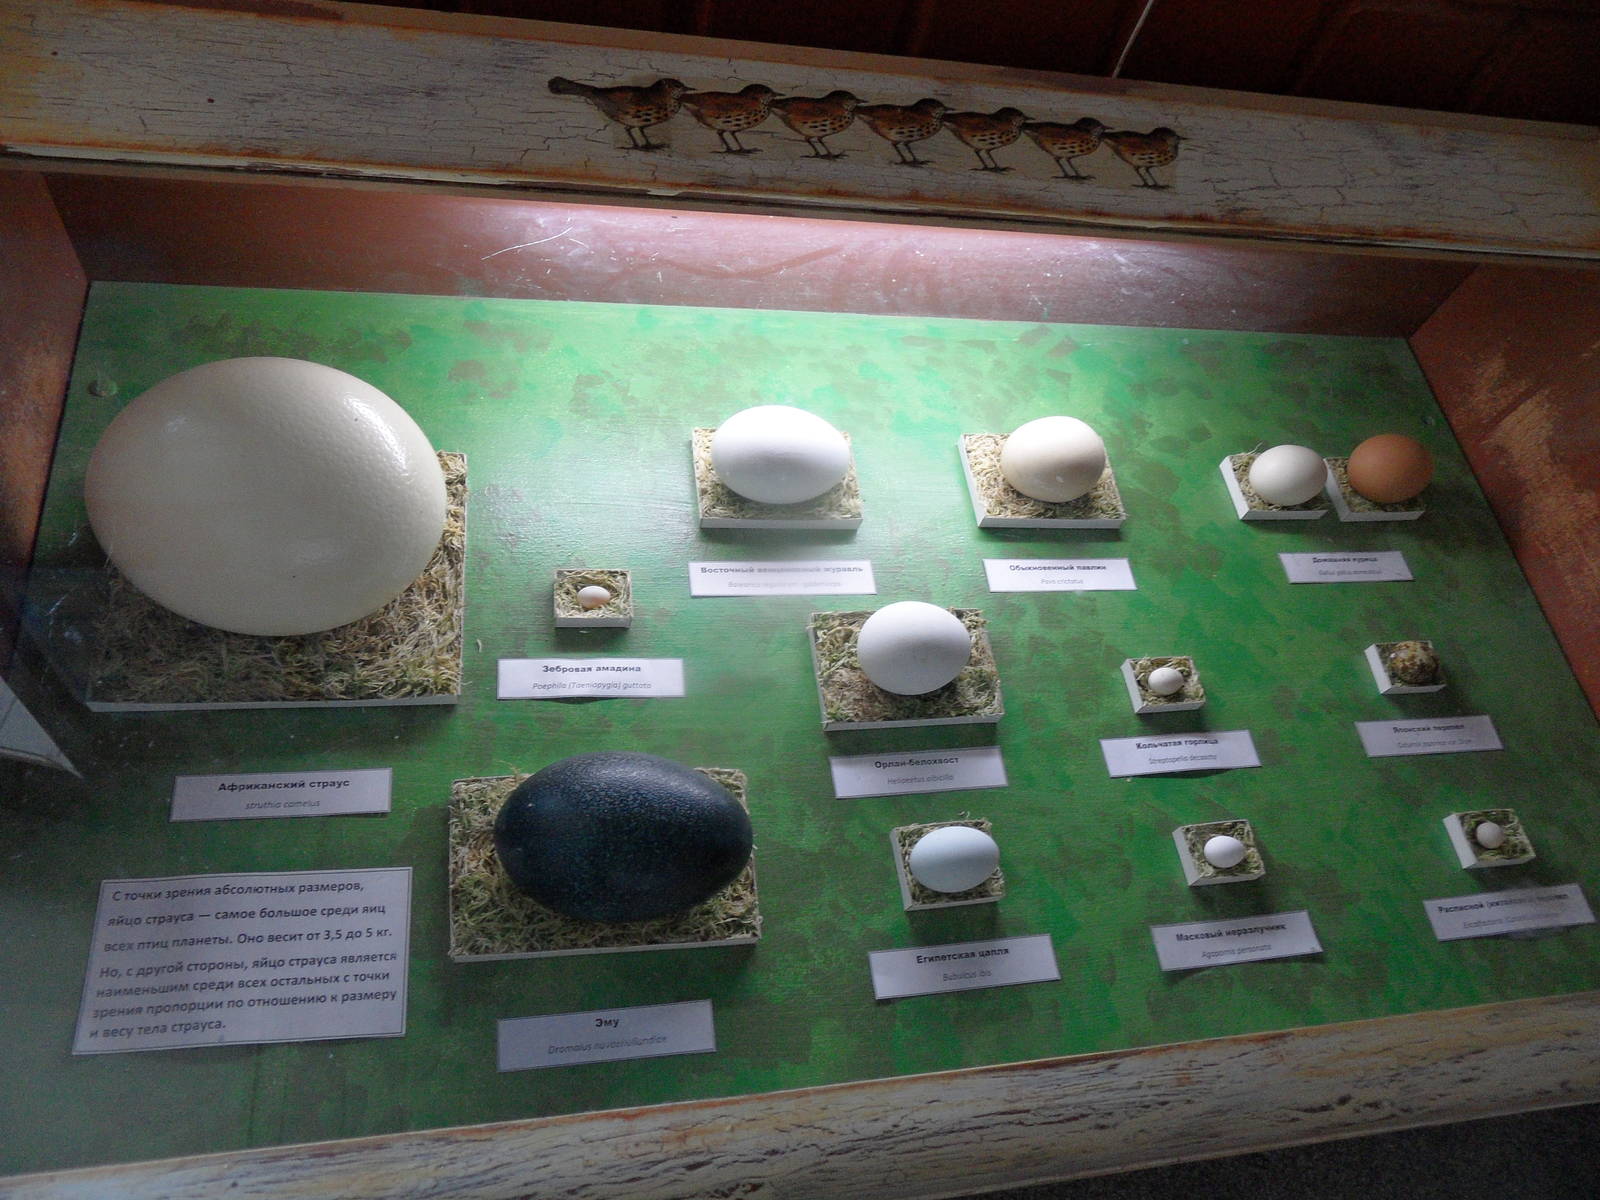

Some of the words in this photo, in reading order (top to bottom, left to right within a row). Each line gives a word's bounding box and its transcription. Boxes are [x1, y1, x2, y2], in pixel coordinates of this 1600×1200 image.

[1009, 564, 1075, 572] Обыкновенный
[542, 664, 593, 674] Зебровая
[595, 665, 642, 673] амадина
[1136, 740, 1181, 749] Кольчатая
[1184, 739, 1218, 748] горлица
[875, 757, 959, 769] Орлан-белохвост
[219, 780, 305, 792] Африканский
[309, 780, 350, 790] страус
[124, 890, 161, 900] точки
[165, 886, 210, 900] зрения
[215, 882, 295, 896] абсолютных
[299, 880, 364, 896] размеров,
[107, 913, 141, 927] яйцо
[145, 911, 194, 926] страуса
[215, 909, 256, 920] самое
[259, 905, 317, 918] большое
[320, 904, 358, 917] среди
[362, 904, 386, 915] яиц
[104, 940, 133, 952] всех
[137, 938, 169, 950] птиц
[172, 934, 233, 947] планеты.
[237, 932, 264, 944] Оно
[267, 931, 303, 942] весит
[306, 931, 320, 940] от
[324, 929, 342, 941] 3,5
[345, 929, 362, 940] до
[366, 928, 373, 938] 5
[376, 928, 392, 938] кг.
[1176, 929, 1223, 941] Масковый
[1225, 924, 1286, 937] неразлучник
[917, 951, 976, 963] Египетская
[979, 948, 1010, 958] цапля
[100, 966, 122, 980] Но,
[127, 967, 133, 976] с
[137, 960, 184, 978] другой
[187, 959, 249, 973] стороны,
[252, 955, 285, 969] яйцо
[289, 955, 337, 969] страуса
[340, 952, 397, 964] является
[96, 982, 189, 998] наименьшим
[193, 979, 233, 993] среди
[238, 976, 267, 988] всех
[270, 973, 340, 986] остальных
[342, 973, 351, 983] с
[353, 971, 389, 981] точки
[93, 1005, 142, 1019] зрения
[146, 999, 223, 1015] пропорции
[227, 998, 243, 1008] по
[247, 994, 327, 1007] отношению
[330, 994, 337, 1003] к
[341, 989, 397, 1004] размеру
[90, 1029, 98, 1039] и
[102, 1025, 134, 1039] весу
[138, 1023, 168, 1035] тела
[171, 1019, 226, 1034] страуса.
[595, 1018, 619, 1028] Эму
